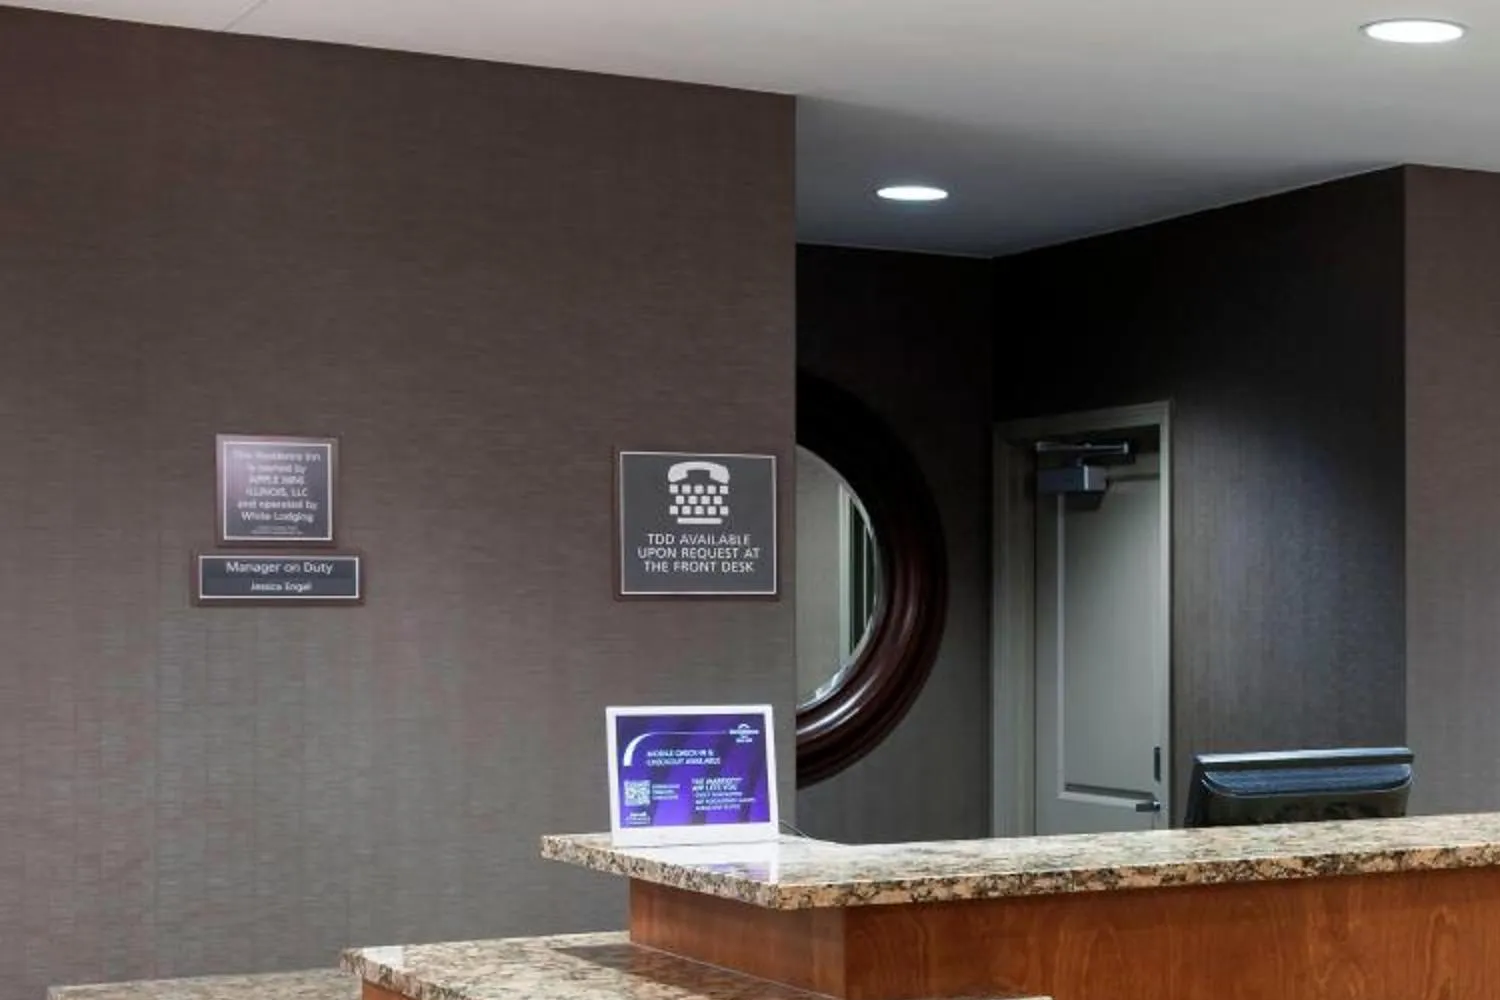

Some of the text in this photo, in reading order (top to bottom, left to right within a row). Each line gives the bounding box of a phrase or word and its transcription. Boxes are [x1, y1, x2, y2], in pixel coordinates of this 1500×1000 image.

[291, 487, 308, 497] LLC
[237, 500, 318, 512] and operated by
[241, 511, 314, 523] White Lodging
[648, 533, 752, 545] TDD AVAILABLE
[637, 547, 761, 560] UPON REQUEST AT
[226, 561, 334, 576] Manager on Duty
[644, 561, 754, 573] THE FRONT DESK
[250, 581, 313, 593] Jessica Engel
